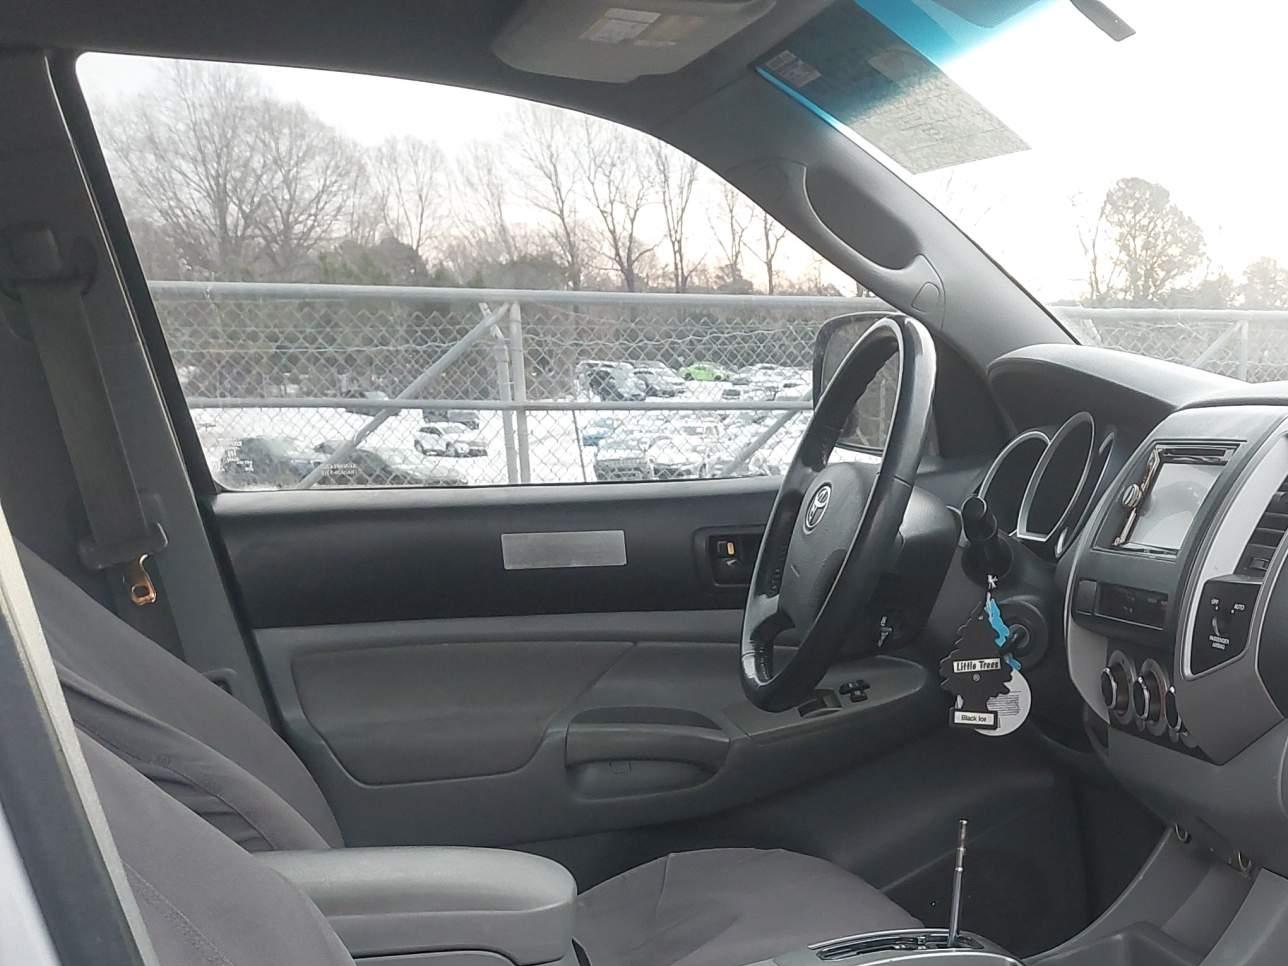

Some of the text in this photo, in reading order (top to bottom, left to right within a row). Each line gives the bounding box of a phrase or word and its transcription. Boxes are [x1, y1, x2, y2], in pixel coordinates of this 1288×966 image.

[956, 660, 999, 672] Little Trees
[961, 714, 976, 722] Black
